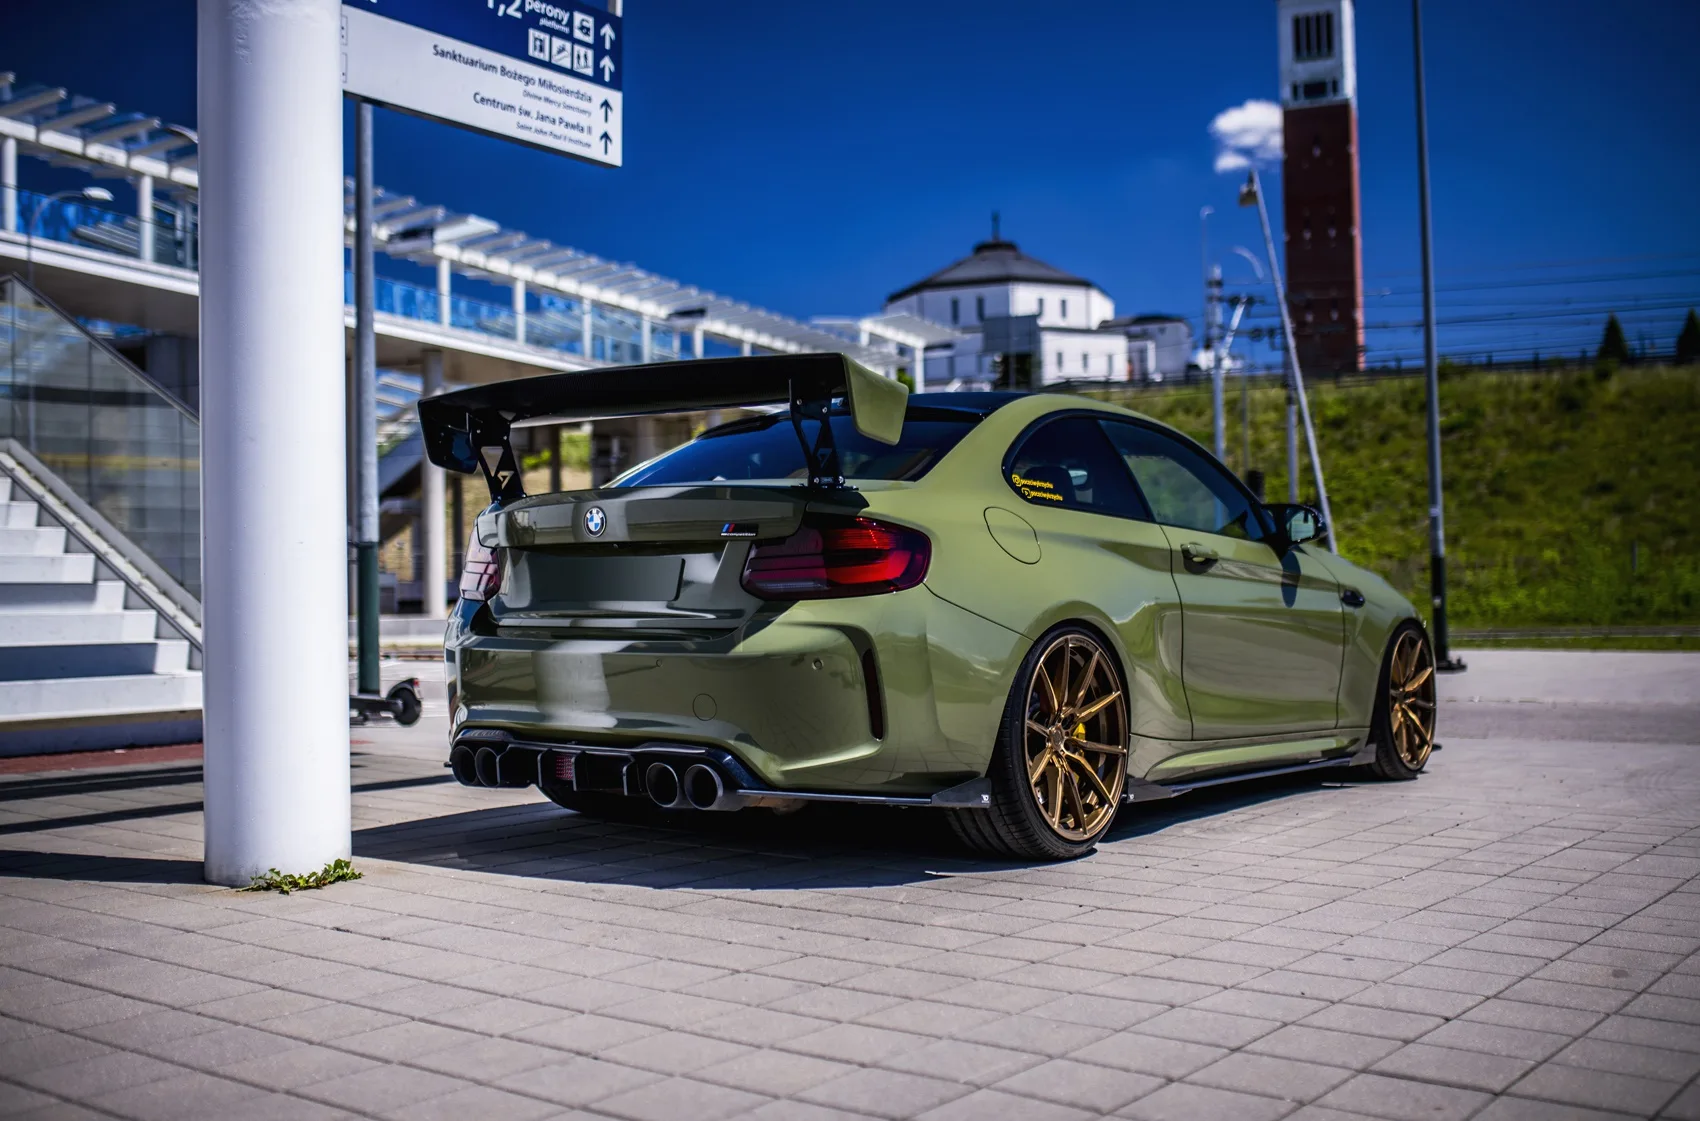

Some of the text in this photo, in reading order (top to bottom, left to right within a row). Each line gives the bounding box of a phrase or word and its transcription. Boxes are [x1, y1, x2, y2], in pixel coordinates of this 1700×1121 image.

[525, 0, 570, 25] perony
[432, 44, 592, 103] Sanktuarium Bożego Miłosierdzia
[473, 92, 516, 114] Centrum
[535, 110, 556, 125] Jana
[558, 116, 584, 134] Pawła
